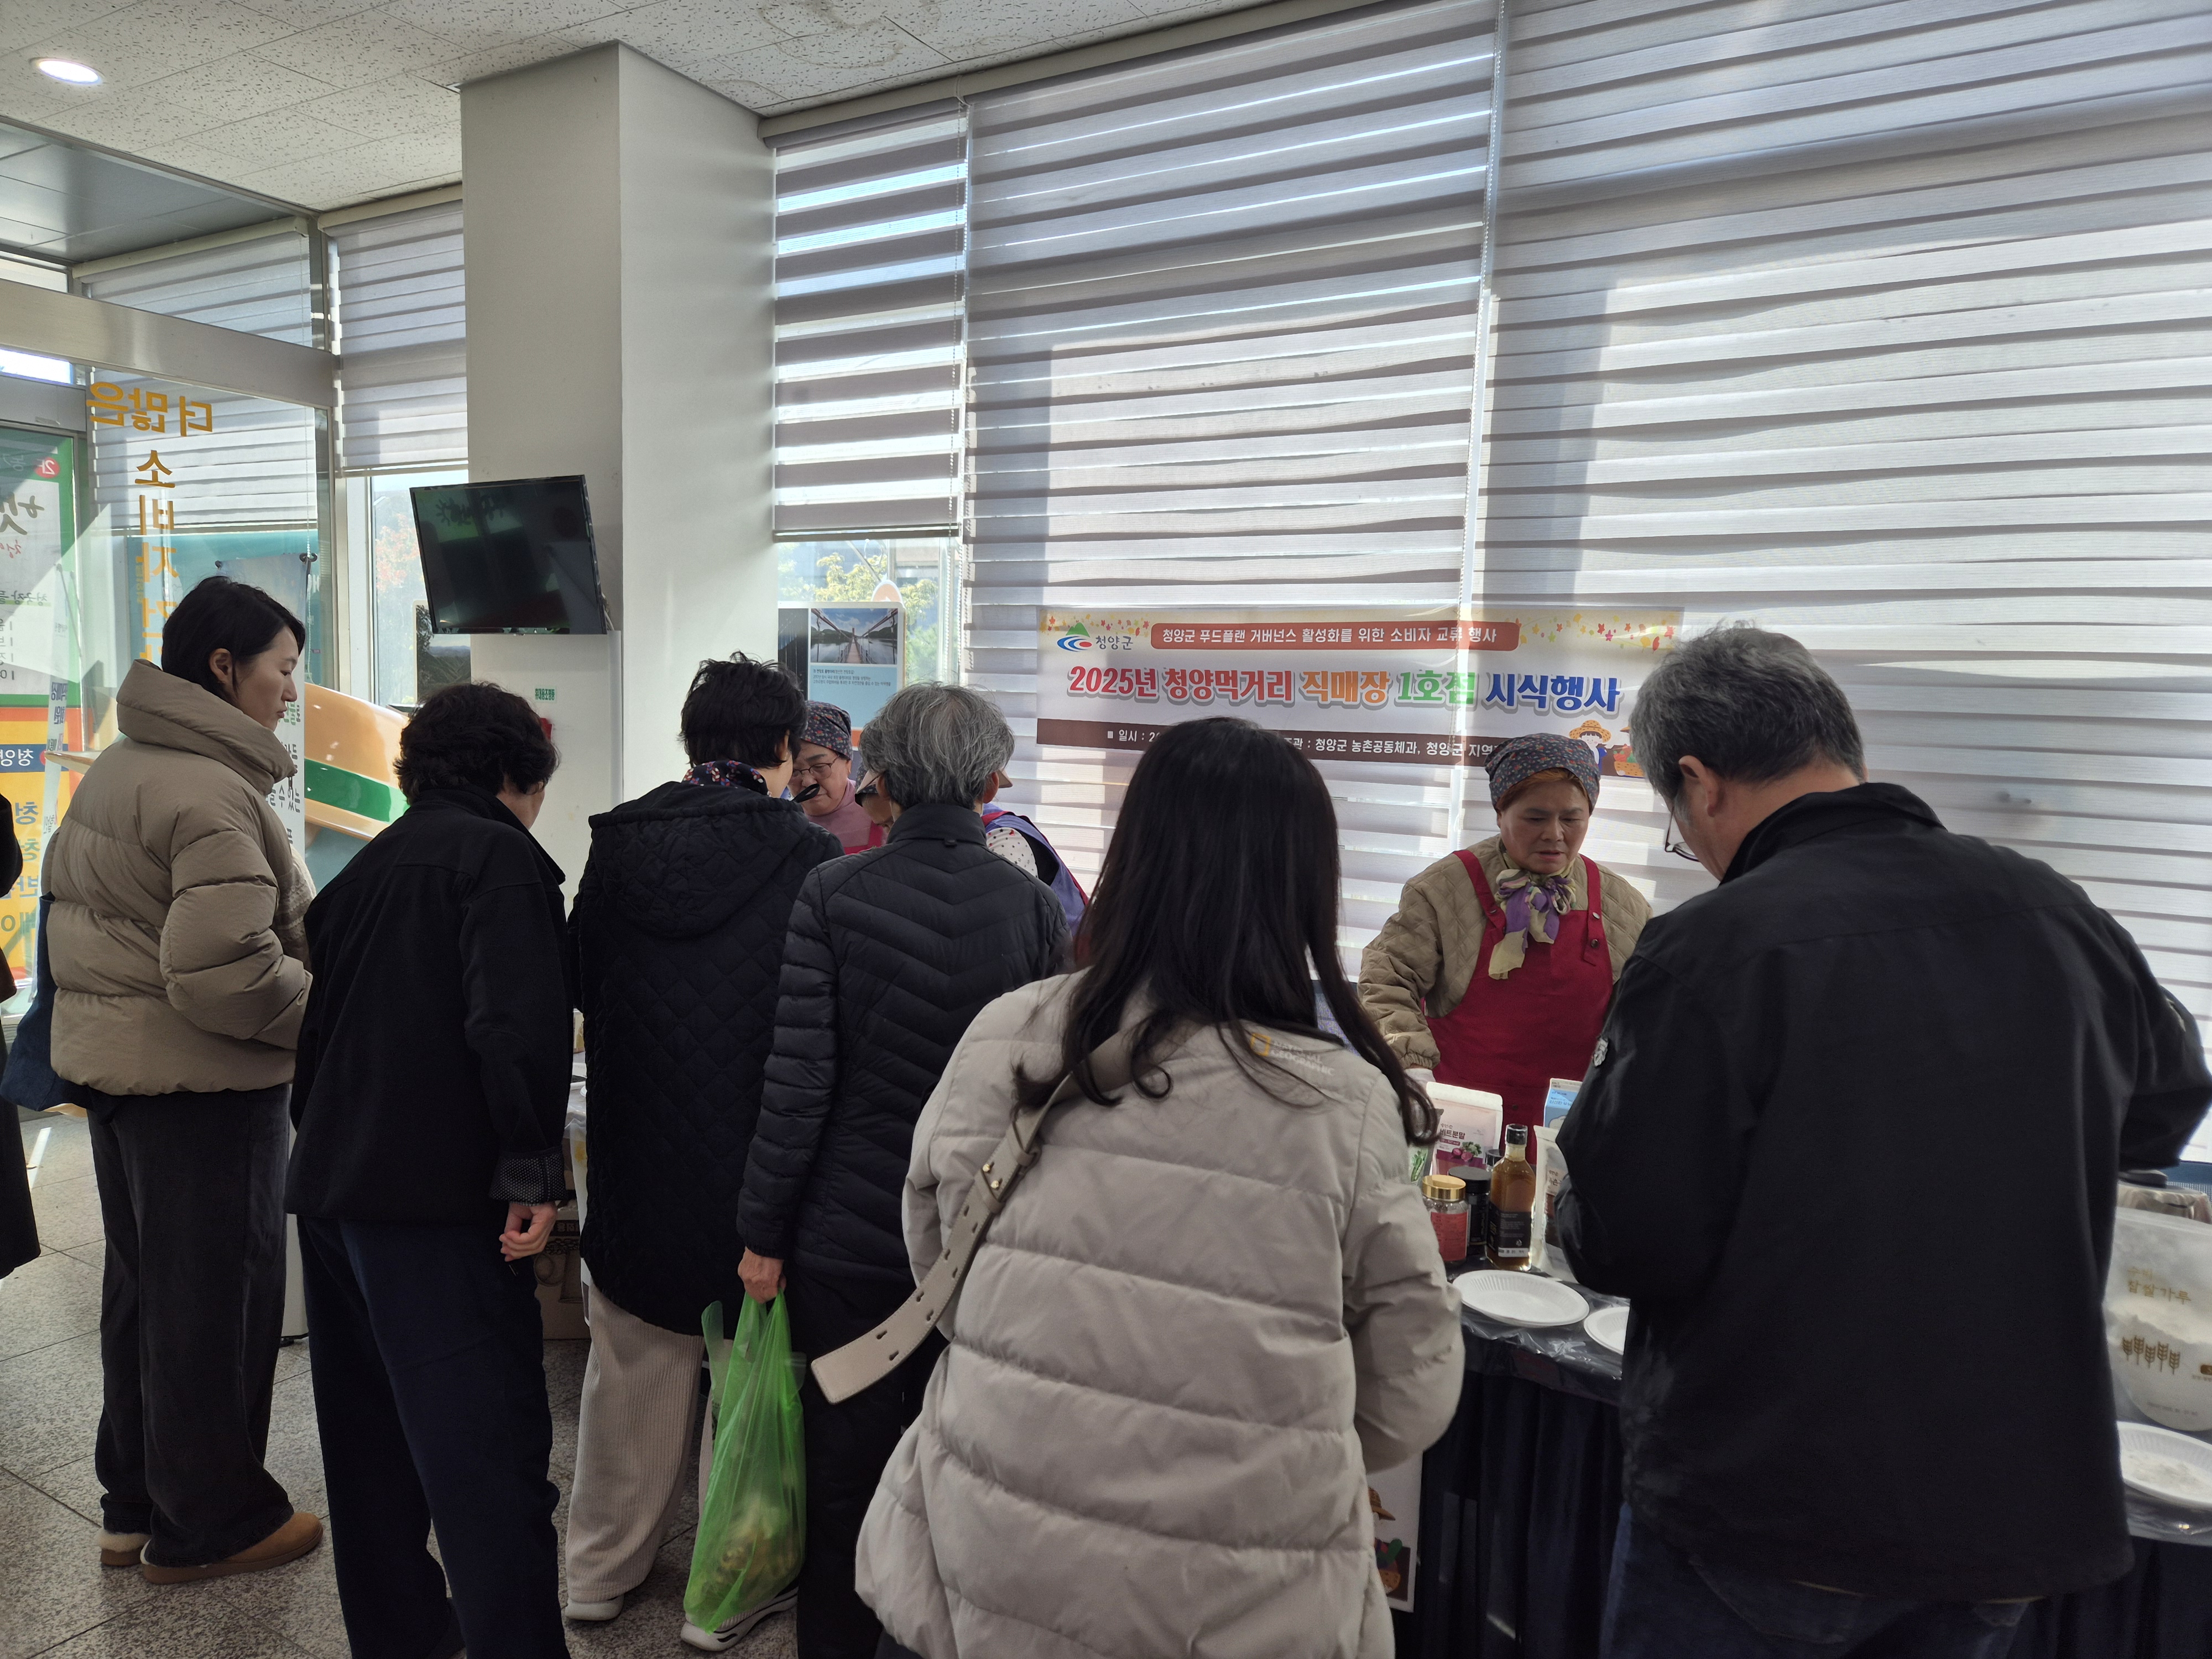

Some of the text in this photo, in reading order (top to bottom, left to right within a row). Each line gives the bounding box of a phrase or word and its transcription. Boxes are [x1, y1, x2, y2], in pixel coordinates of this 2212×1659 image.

[1095, 634, 1133, 651] 청양군
[1162, 627, 1497, 644] 청양군 푸드플랜 거버넌스 활성화를 위한 소비자 교류 행사
[1068, 665, 1621, 713] 2025년 청양먹거리 직매장 1호점 시식행사
[1118, 729, 1138, 743] 일시
[1315, 738, 1347, 752] 청양군
[1351, 739, 1421, 755] 농촌공동체과,
[1426, 742, 1464, 757] 청양군
[1468, 743, 1496, 758] 지역
[278, 784, 285, 808] 수
[2127, 1279, 2192, 1305] 찹쌀가루
